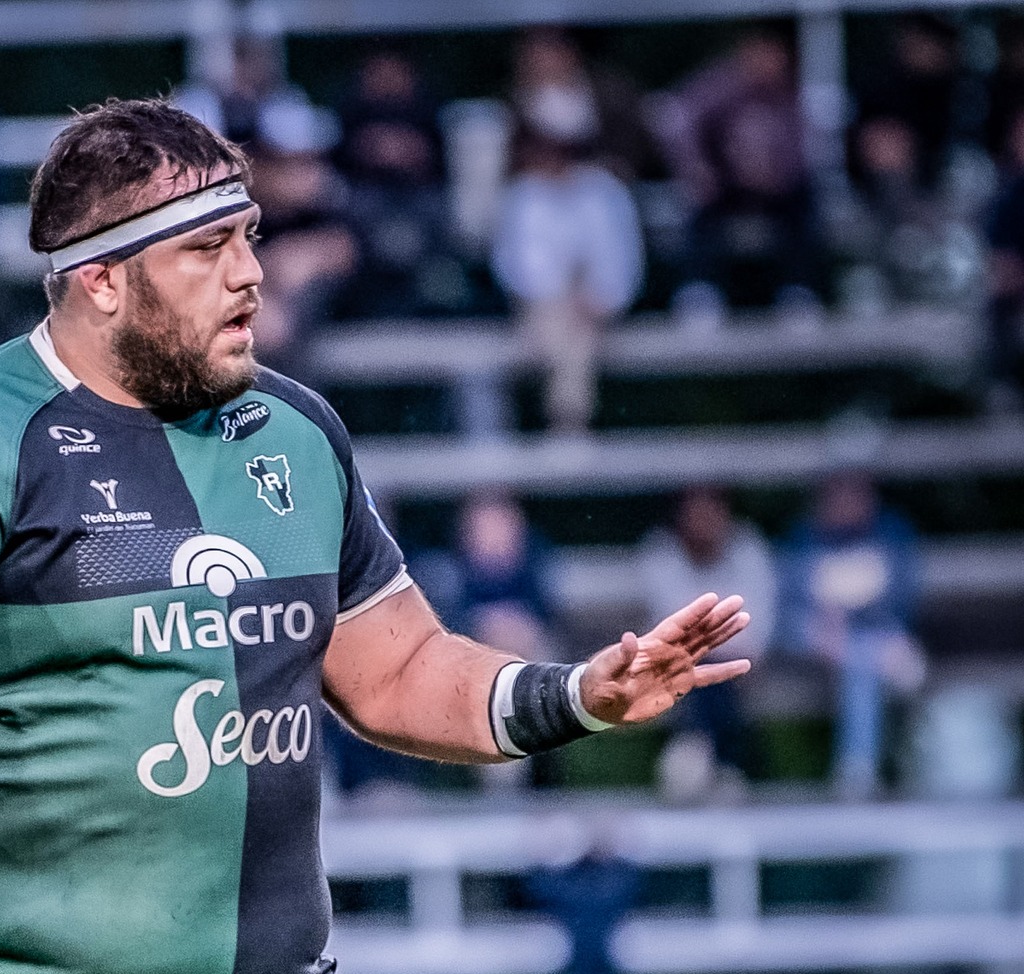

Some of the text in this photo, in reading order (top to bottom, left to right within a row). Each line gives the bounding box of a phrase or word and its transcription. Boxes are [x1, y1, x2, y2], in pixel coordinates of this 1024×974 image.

[59, 444, 101, 456] quince
[262, 472, 283, 491] R
[81, 511, 152, 524] Yerba Buena
[133, 600, 316, 657] Macro
[136, 679, 312, 797] Secco
